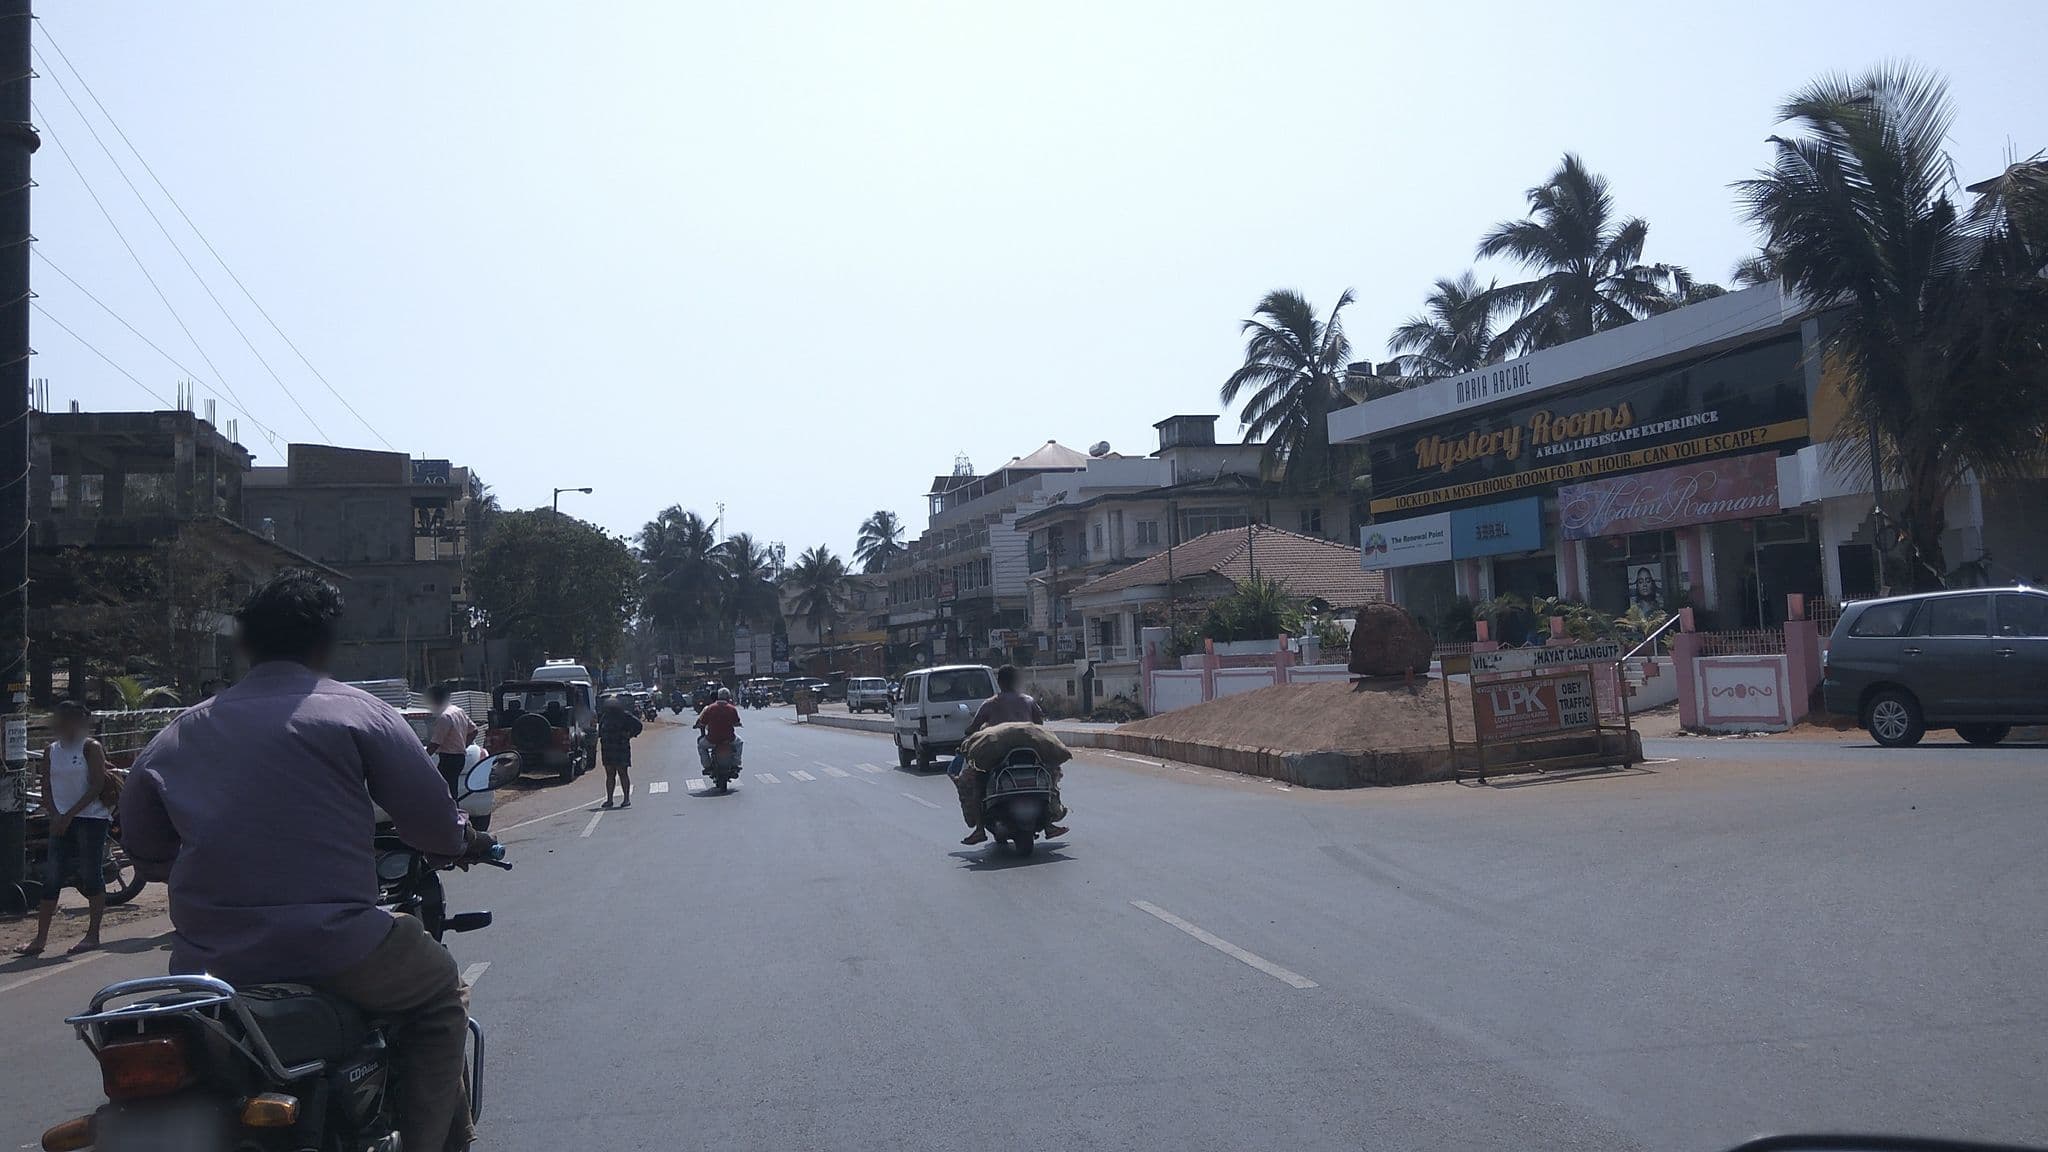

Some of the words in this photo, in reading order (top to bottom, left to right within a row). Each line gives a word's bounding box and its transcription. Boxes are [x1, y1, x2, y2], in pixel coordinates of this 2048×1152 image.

[1456, 373, 1488, 404] MARIA
[1493, 362, 1532, 394] ARCADE
[1415, 424, 1522, 473] Mystery
[1529, 401, 1634, 446] Rooms
[1536, 447, 1543, 458] A
[1544, 441, 1573, 456] REAL
[1574, 435, 1599, 452] LIFE
[1599, 427, 1641, 448] ESCAPE
[1642, 410, 1719, 437] EXPERIENCE
[1395, 492, 1430, 509] LOCKED
[1432, 491, 1441, 504] IN
[1444, 489, 1452, 500] A
[1453, 478, 1513, 499] MYSTERIOUS
[1515, 472, 1550, 488] ROOM
[1551, 464, 1574, 480] FOR
[1579, 461, 1594, 476] AN
[1643, 449, 1670, 465] CAN
[1674, 442, 1701, 460] YOU
[1705, 428, 1768, 453] ESCAPE?
[1563, 478, 1663, 529] Malini
[1650, 471, 1778, 525] Ramani
[1391, 536, 1402, 545] The
[1403, 532, 1427, 543] Renewal
[1428, 529, 1444, 539] Point
[1490, 685, 1547, 717] LPK
[1559, 696, 1592, 710] TRAFFIC
[1561, 682, 1581, 695] OBEY
[1563, 712, 1589, 727] RULES
